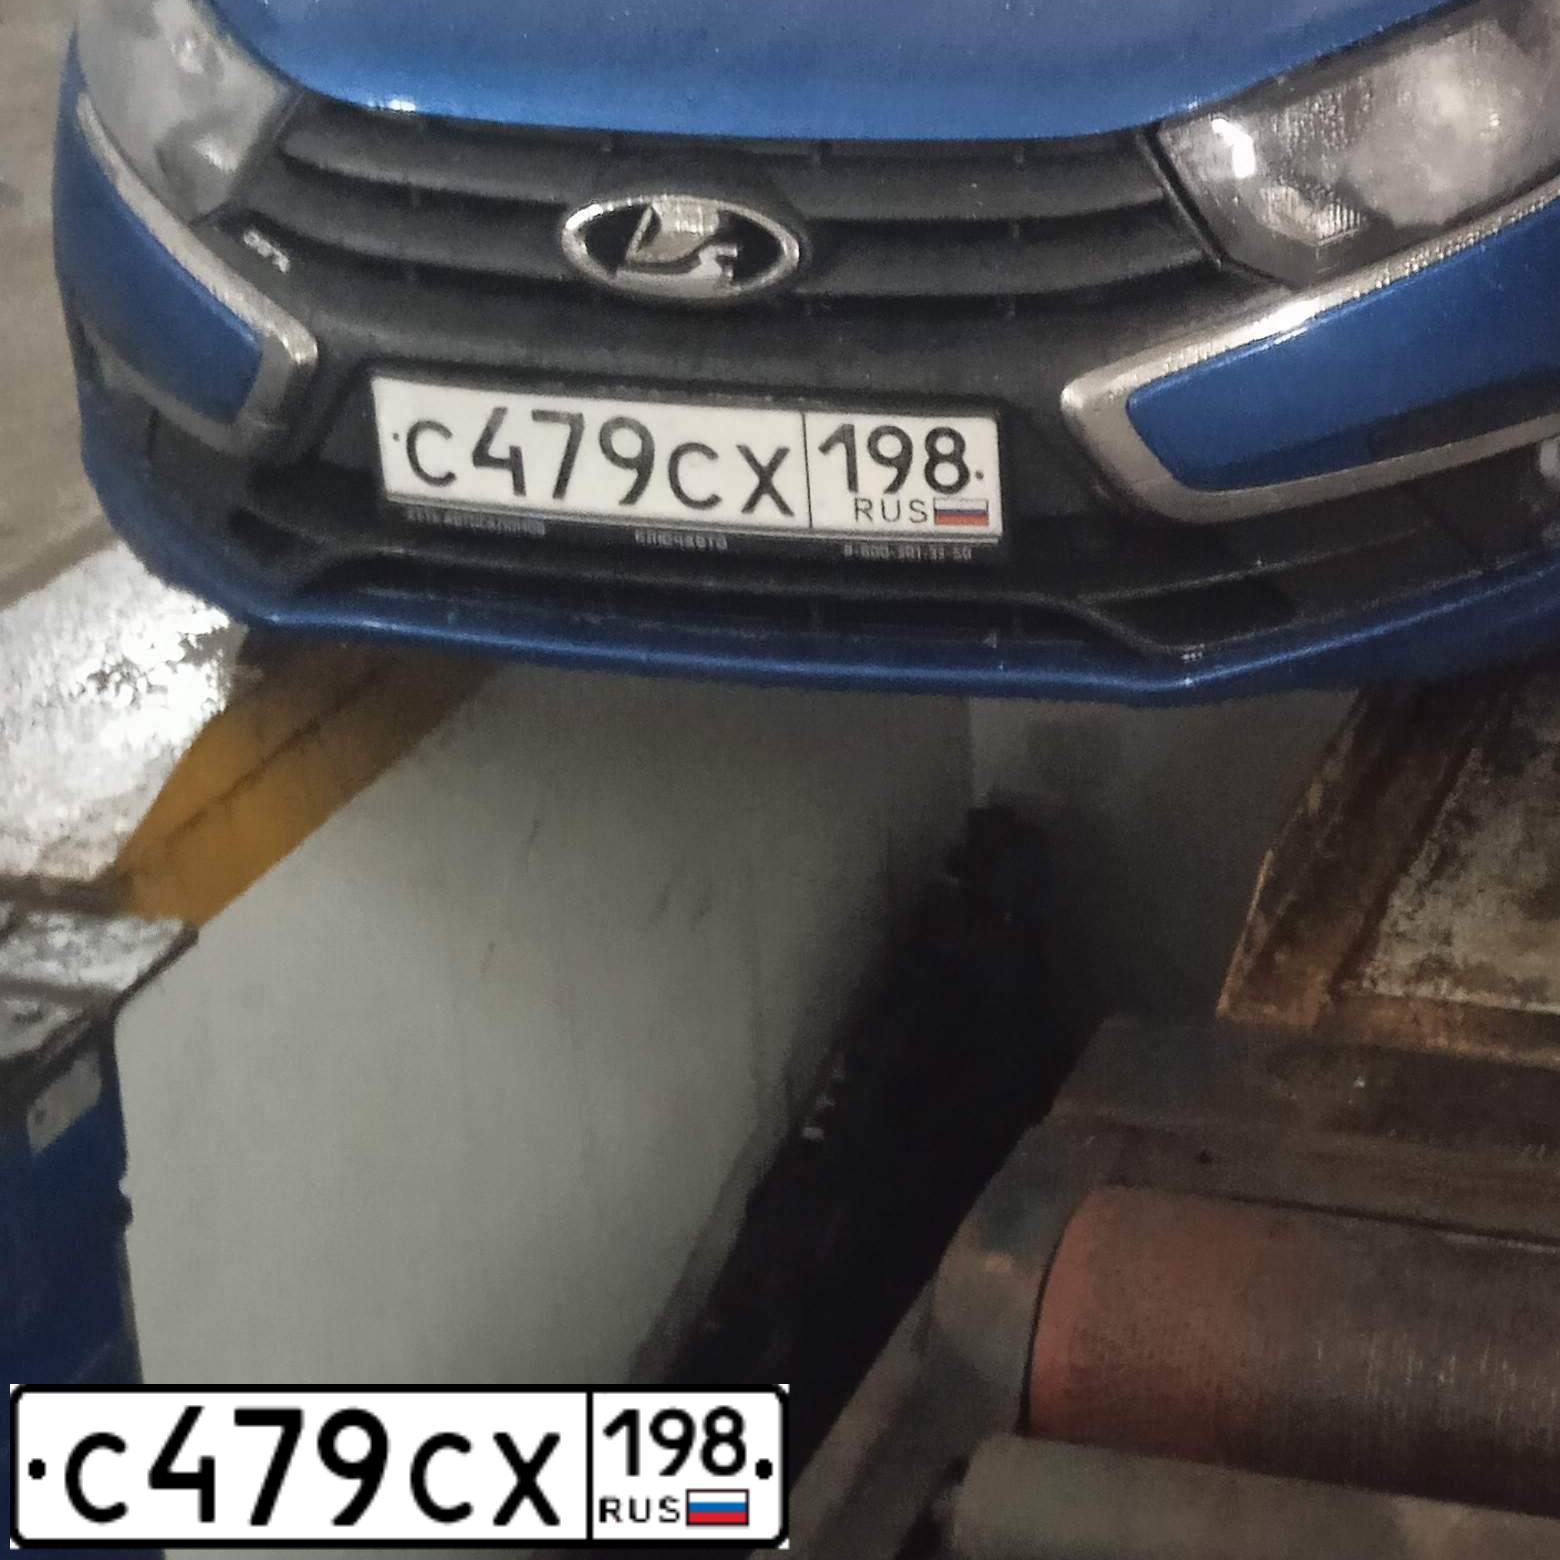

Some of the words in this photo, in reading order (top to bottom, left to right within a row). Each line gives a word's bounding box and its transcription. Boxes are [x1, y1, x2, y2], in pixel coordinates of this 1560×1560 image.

[405, 406, 795, 518] С479СХ
[817, 422, 970, 495] 198
[853, 497, 928, 524] RUS
